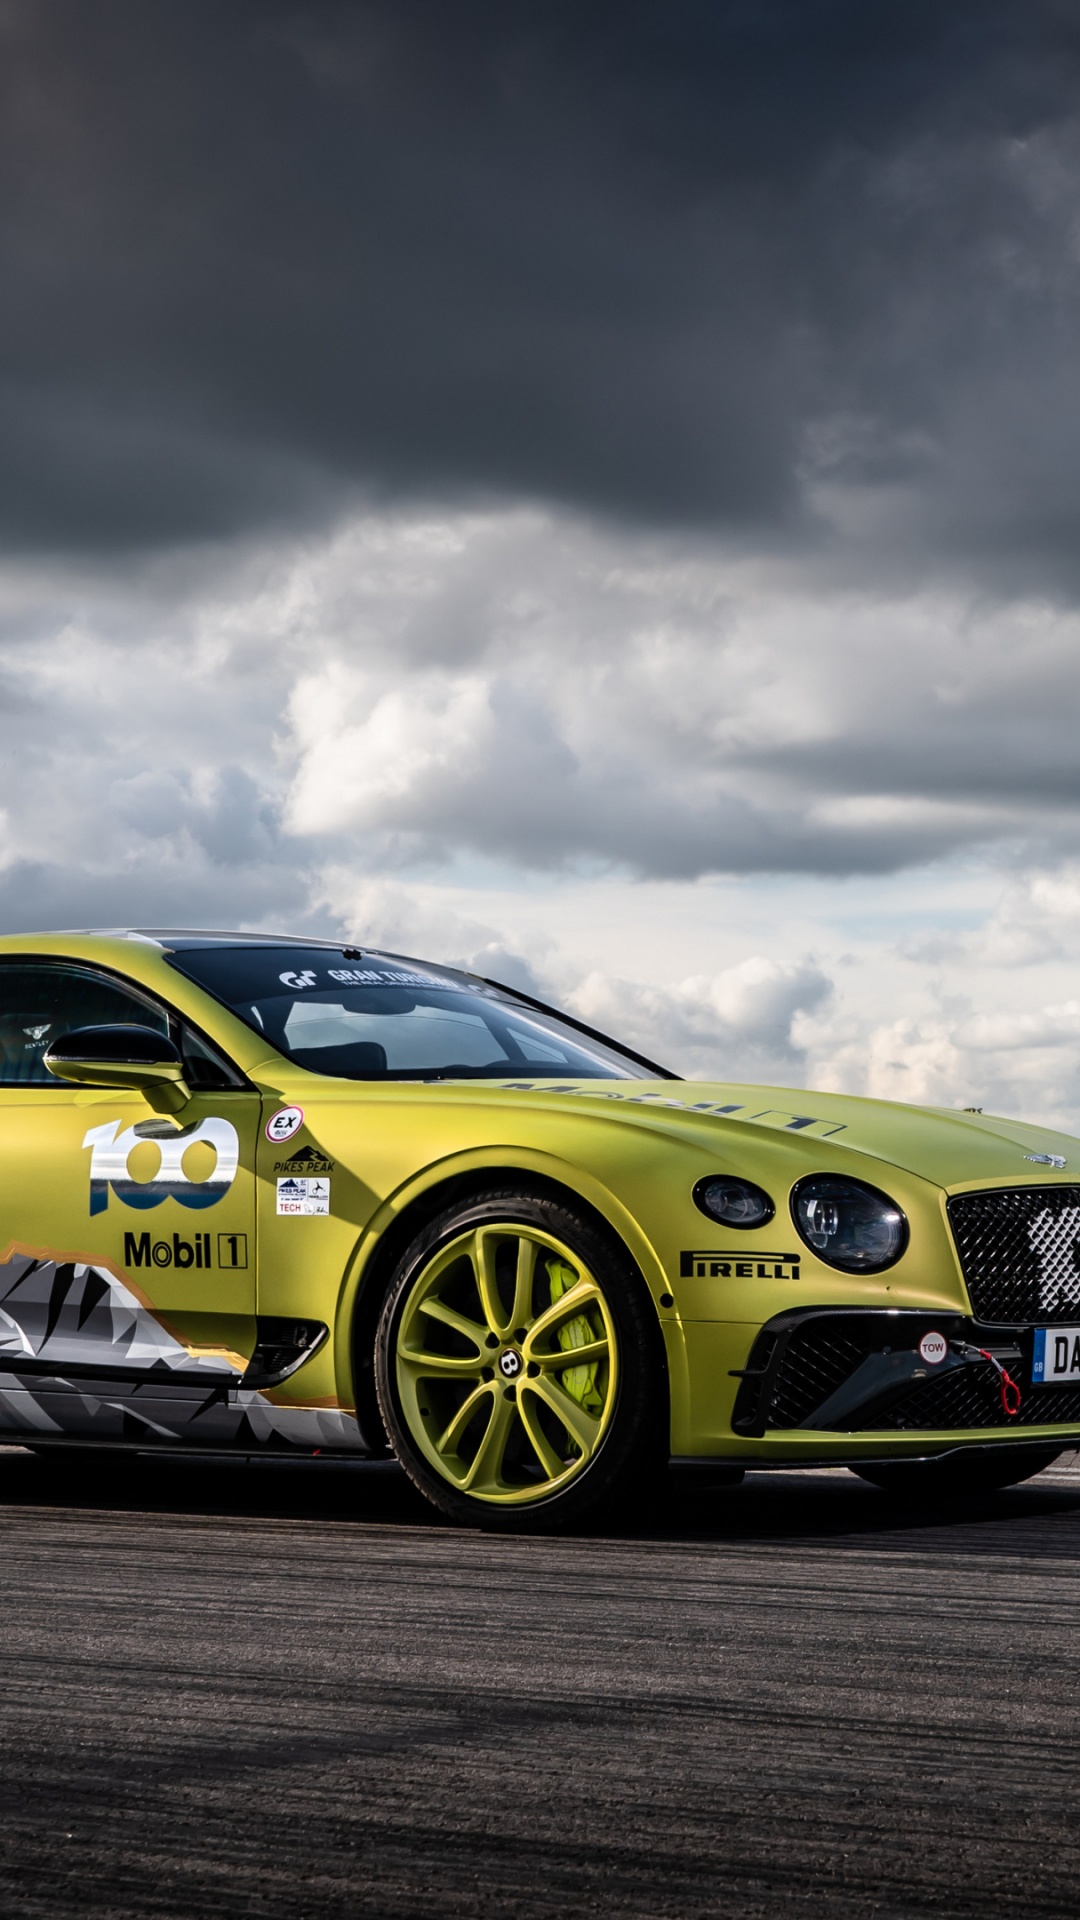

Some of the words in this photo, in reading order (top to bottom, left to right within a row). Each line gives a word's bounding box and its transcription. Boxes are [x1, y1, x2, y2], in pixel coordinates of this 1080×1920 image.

[327, 970, 384, 981] GRAN
[379, 971, 460, 989] TURISMO
[273, 1116, 297, 1128] EX
[82, 1117, 239, 1217] 100
[273, 1162, 304, 1172] PIKES
[306, 1162, 335, 1172] PEAK
[280, 1203, 301, 1212] TECH
[124, 1231, 212, 1269] Mobil
[680, 1250, 801, 1280] PIRELLI
[922, 1343, 943, 1352] TOW
[1034, 1362, 1043, 1372] GB
